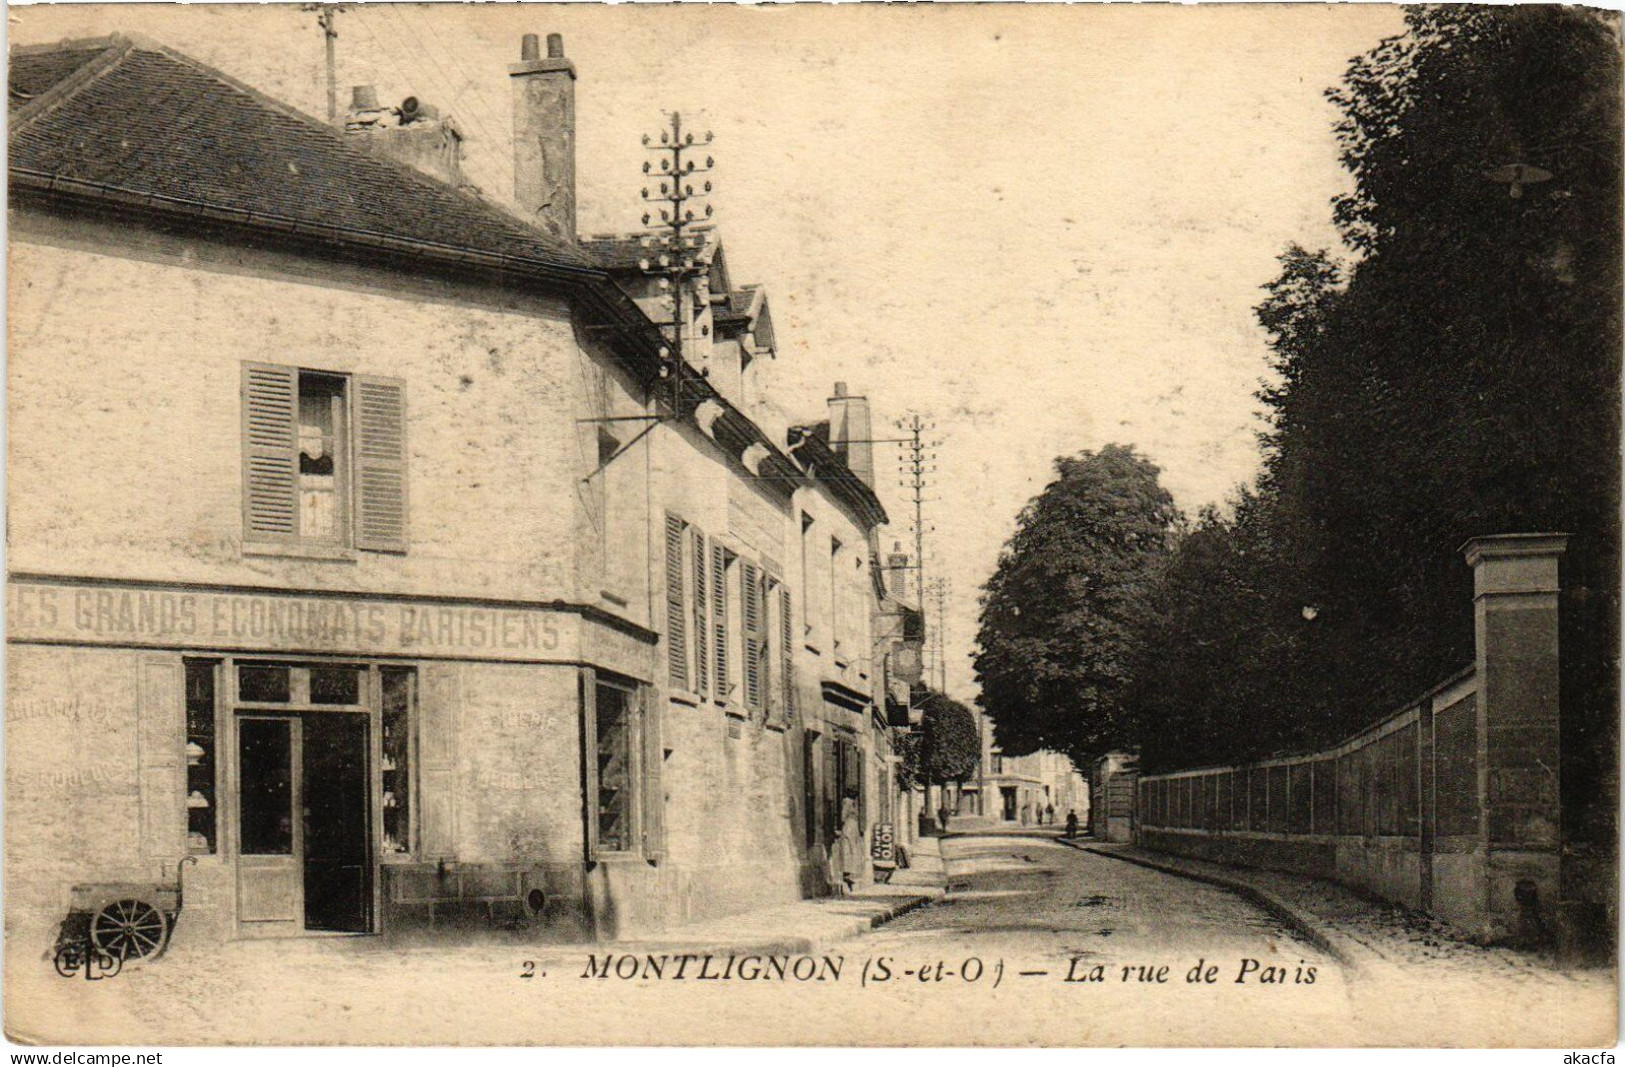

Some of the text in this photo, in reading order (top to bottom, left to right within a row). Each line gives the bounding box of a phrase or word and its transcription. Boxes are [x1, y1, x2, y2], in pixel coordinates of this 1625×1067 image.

[75, 588, 197, 635] GRANDS
[212, 596, 386, 644] ECONOMATS
[400, 606, 559, 651] PARISIENS
[881, 824, 893, 859] MOTO
